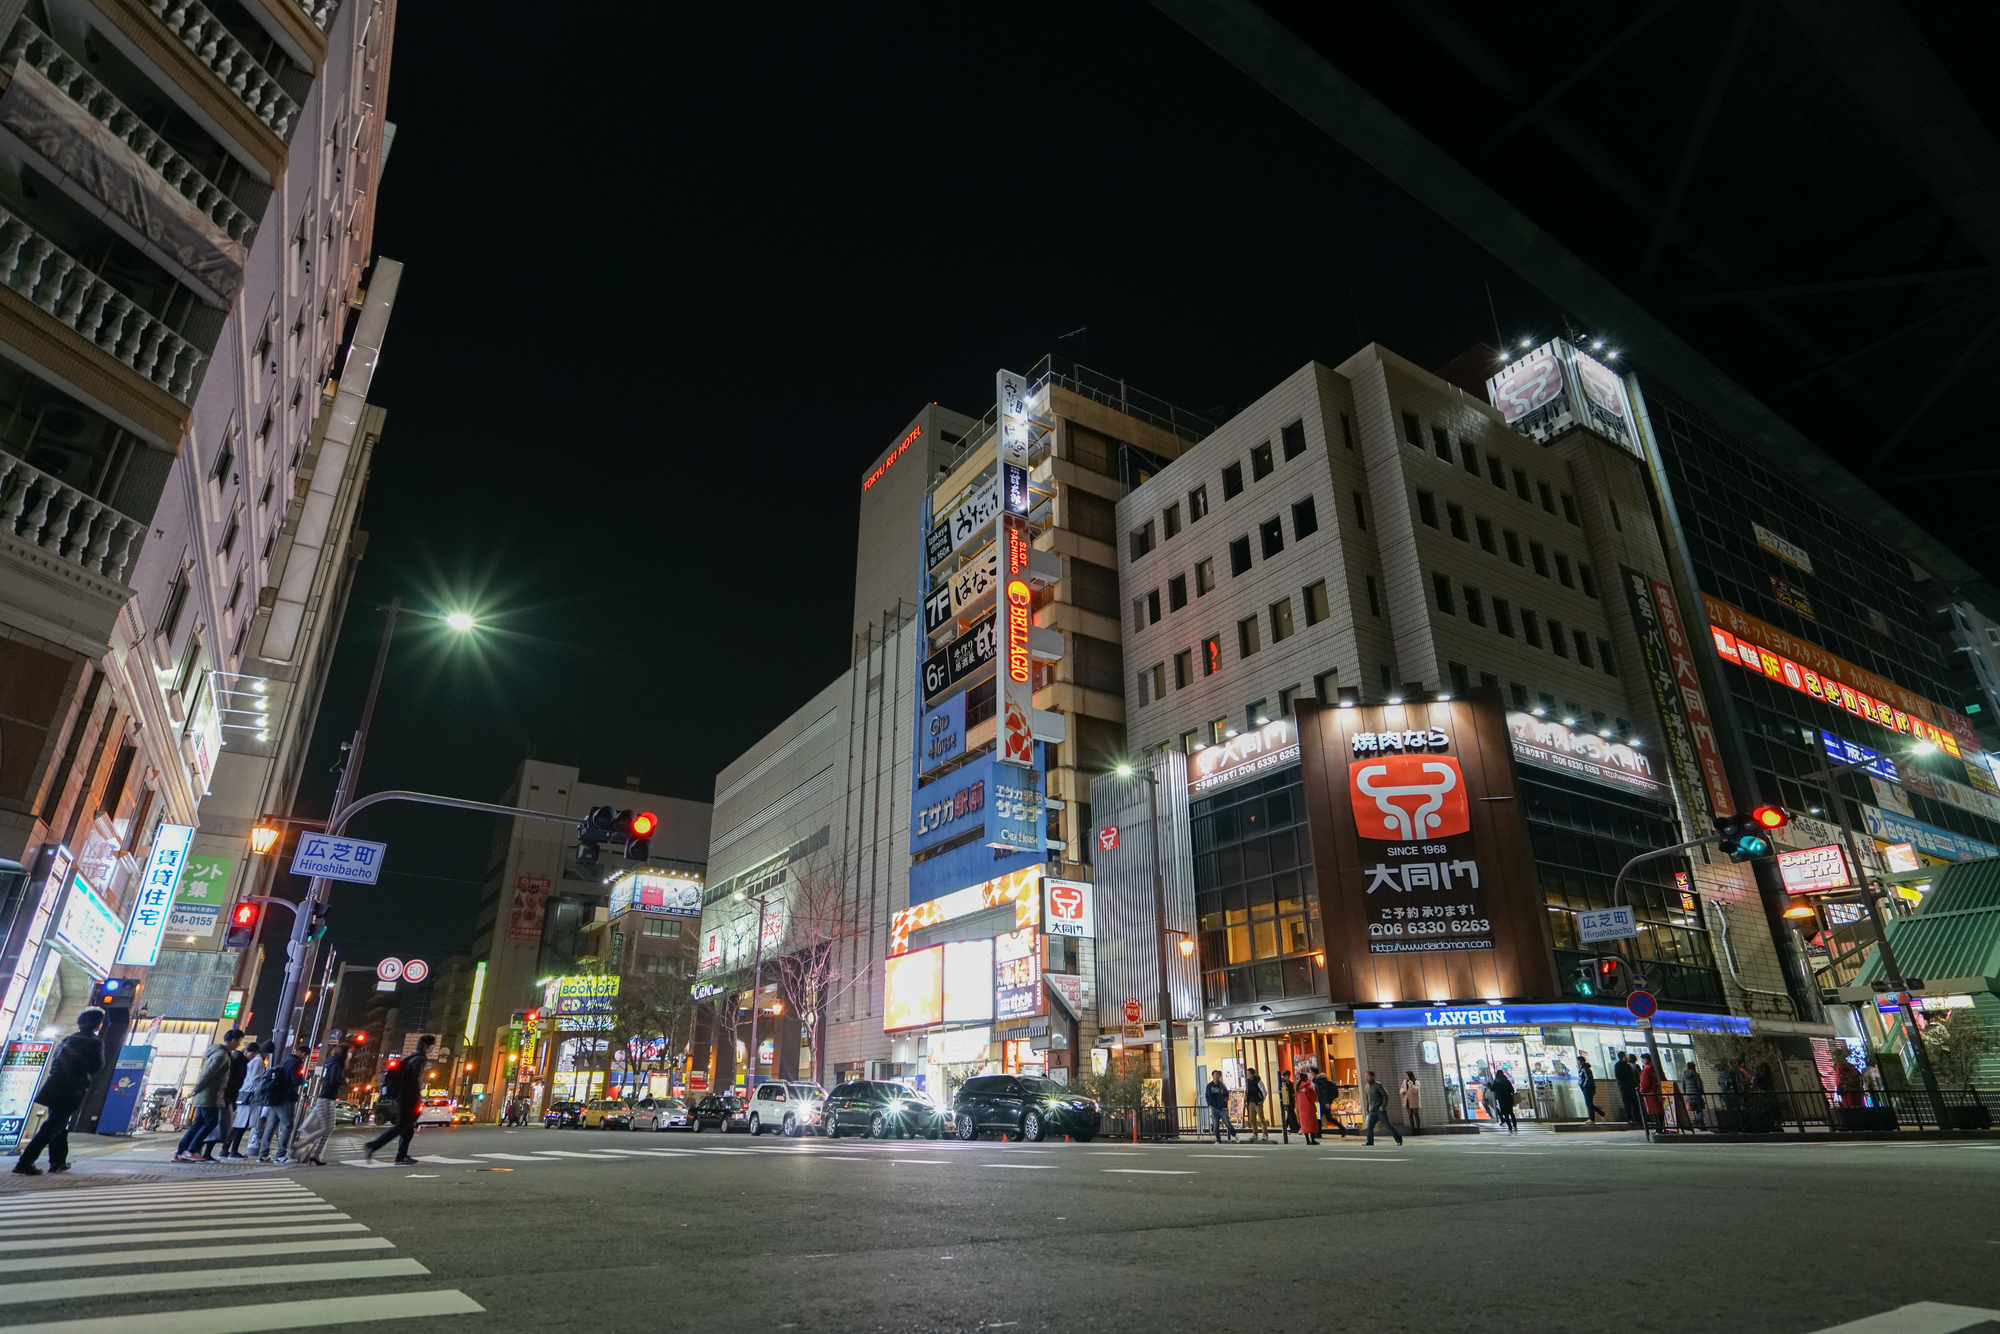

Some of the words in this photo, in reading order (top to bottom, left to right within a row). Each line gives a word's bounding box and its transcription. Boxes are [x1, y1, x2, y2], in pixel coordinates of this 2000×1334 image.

[863, 463, 886, 492] TOKYU
[886, 450, 897, 469] REI
[898, 425, 922, 456] HOTEL
[930, 535, 948, 554] dining
[1010, 528, 1019, 574] PACHINKO
[1020, 541, 1028, 567] SLOT
[925, 587, 950, 628] 7F
[1706, 600, 1725, 625] 2F
[1009, 605, 1030, 683] BELLAGIO
[1737, 643, 1761, 669] 直結
[1760, 652, 1782, 680] 6F
[926, 664, 945, 692] 6F
[1351, 726, 1450, 752] 焼肉なら
[1257, 755, 1278, 769] 6330
[1279, 746, 1300, 761] 6263
[1567, 760, 1584, 771] 6330
[1584, 763, 1600, 775] 6263
[995, 784, 1043, 805] エサカ駅前
[916, 779, 985, 837] エサカ駅前
[995, 799, 1044, 823] サウナ
[304, 839, 377, 866] 広芝町
[1387, 846, 1419, 857] SINCE
[1422, 844, 1447, 855] 1968
[299, 859, 372, 879] Hiroshibacho
[137, 849, 180, 927] 賃貸住宅
[1407, 921, 1447, 934] 6330
[1451, 919, 1490, 932] 6263
[1582, 911, 1629, 930] 広芝町
[1584, 927, 1633, 939] Hiroshibacho
[408, 966, 422, 976] 50
[1424, 1009, 1507, 1026] LAWSON
